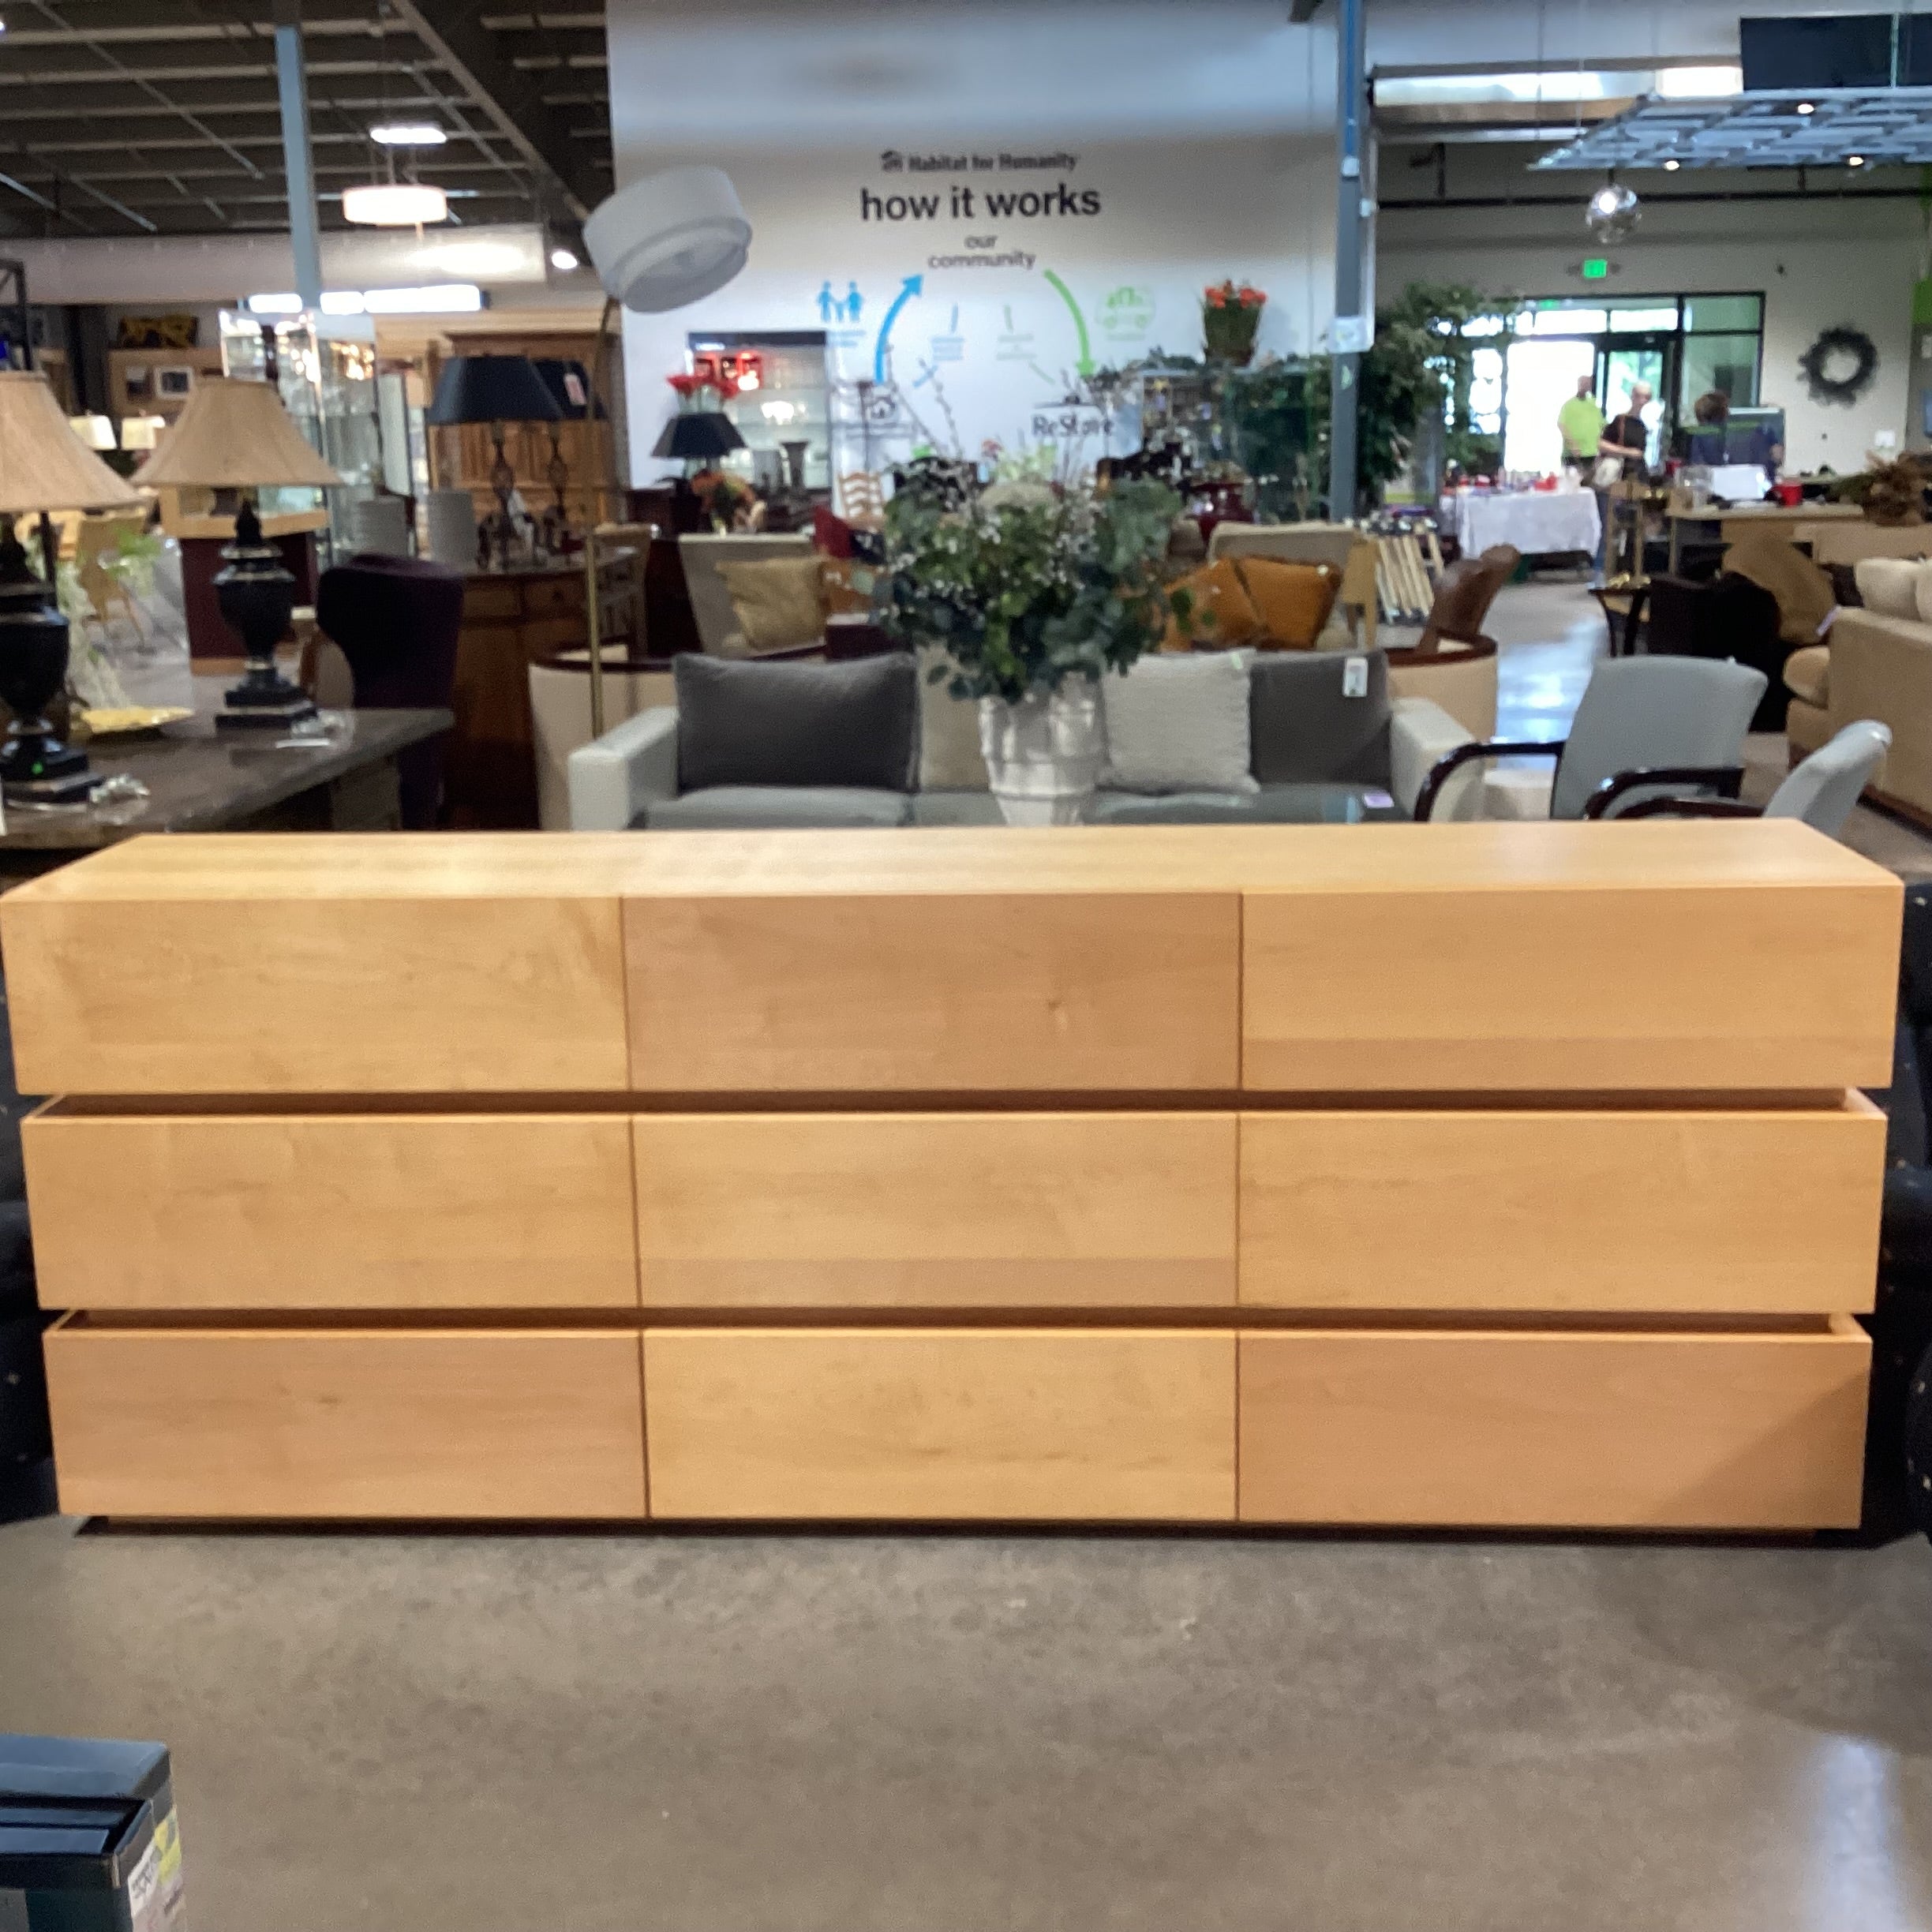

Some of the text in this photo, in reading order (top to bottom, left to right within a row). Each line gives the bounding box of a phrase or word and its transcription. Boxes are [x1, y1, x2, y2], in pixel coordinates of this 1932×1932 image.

[908, 152, 1076, 173] Habitat for Humanity
[860, 183, 1102, 220] how it works
[964, 235, 998, 249] our
[927, 250, 1035, 269] community
